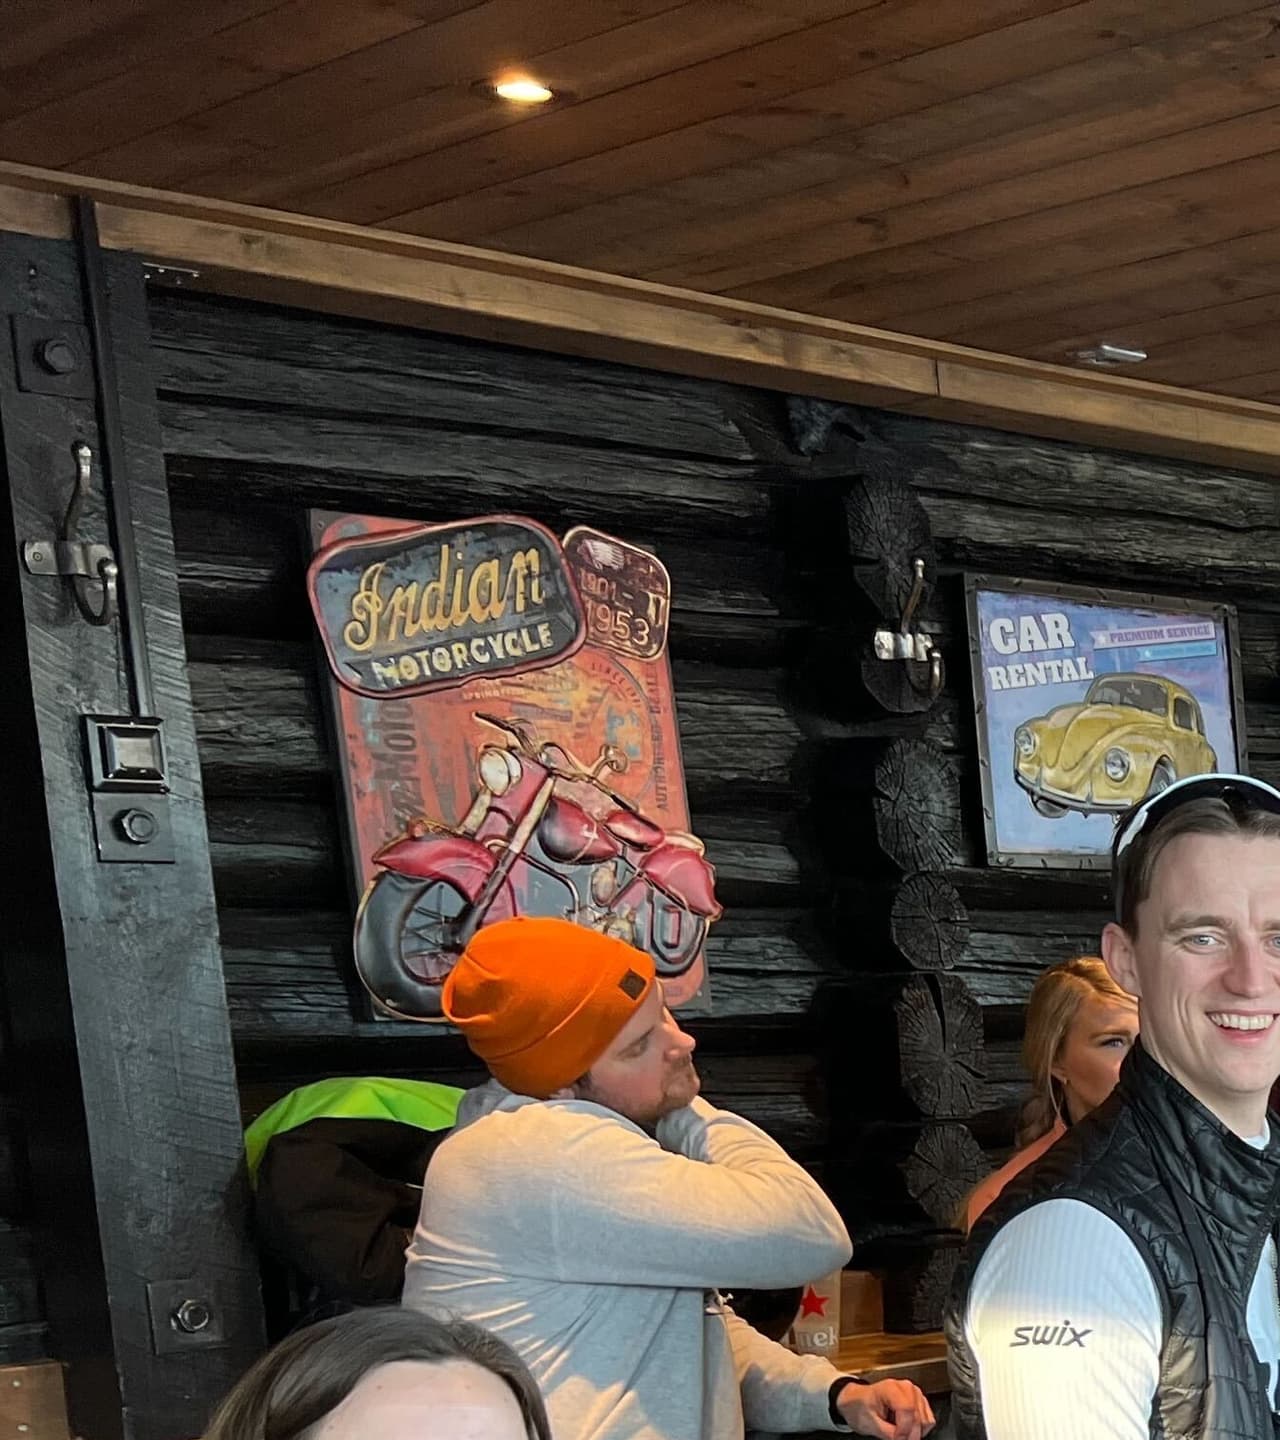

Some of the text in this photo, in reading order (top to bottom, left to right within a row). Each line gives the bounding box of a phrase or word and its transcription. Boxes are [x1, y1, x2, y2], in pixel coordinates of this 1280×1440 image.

[344, 546, 546, 652] Indian
[586, 599, 650, 645] 1953
[989, 612, 1076, 655] CAR
[1109, 623, 1212, 643] PREMIUM SERVICE
[371, 622, 554, 688] MOTORCYCLE
[987, 656, 1095, 692] RENTAL
